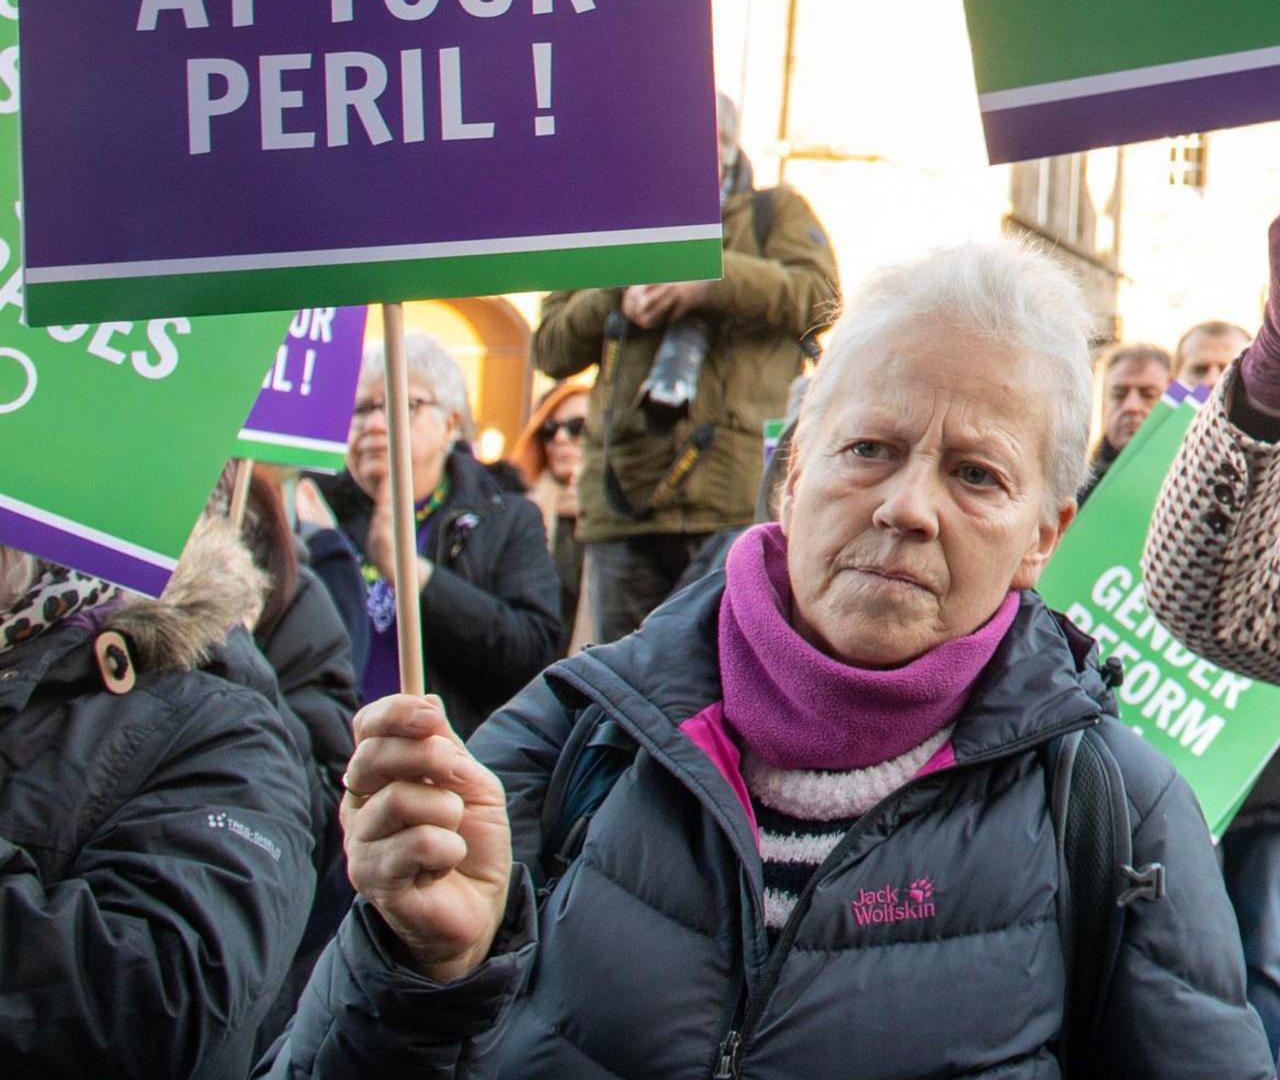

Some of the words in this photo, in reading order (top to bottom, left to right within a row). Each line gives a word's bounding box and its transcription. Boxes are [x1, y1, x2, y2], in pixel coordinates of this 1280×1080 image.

[187, 46, 495, 155] PERIL
[532, 42, 555, 136] !
[852, 885, 898, 906] Jack
[853, 901, 935, 926] Wolfskin
